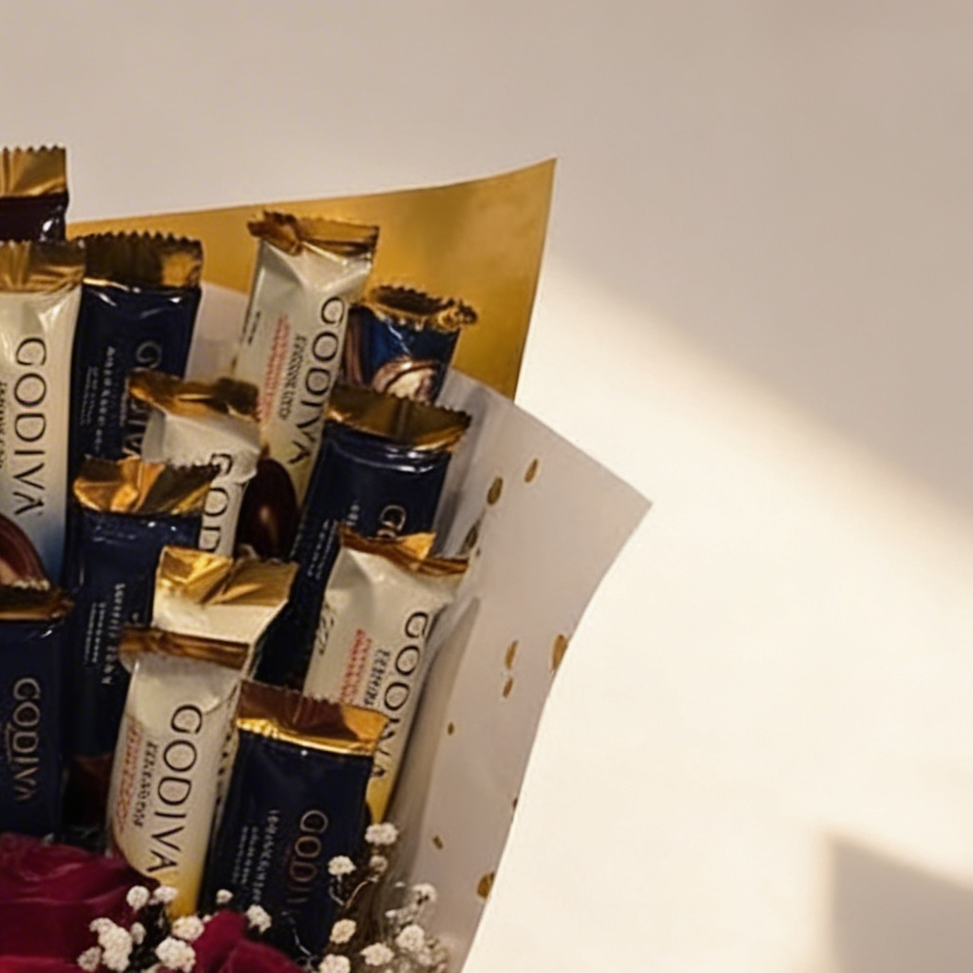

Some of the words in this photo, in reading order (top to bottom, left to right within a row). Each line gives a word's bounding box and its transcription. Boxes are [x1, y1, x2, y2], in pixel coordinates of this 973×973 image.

[13, 336, 47, 516] GODIVA
[287, 296, 344, 464] GODIVA
[146, 704, 203, 874] GODIVA
